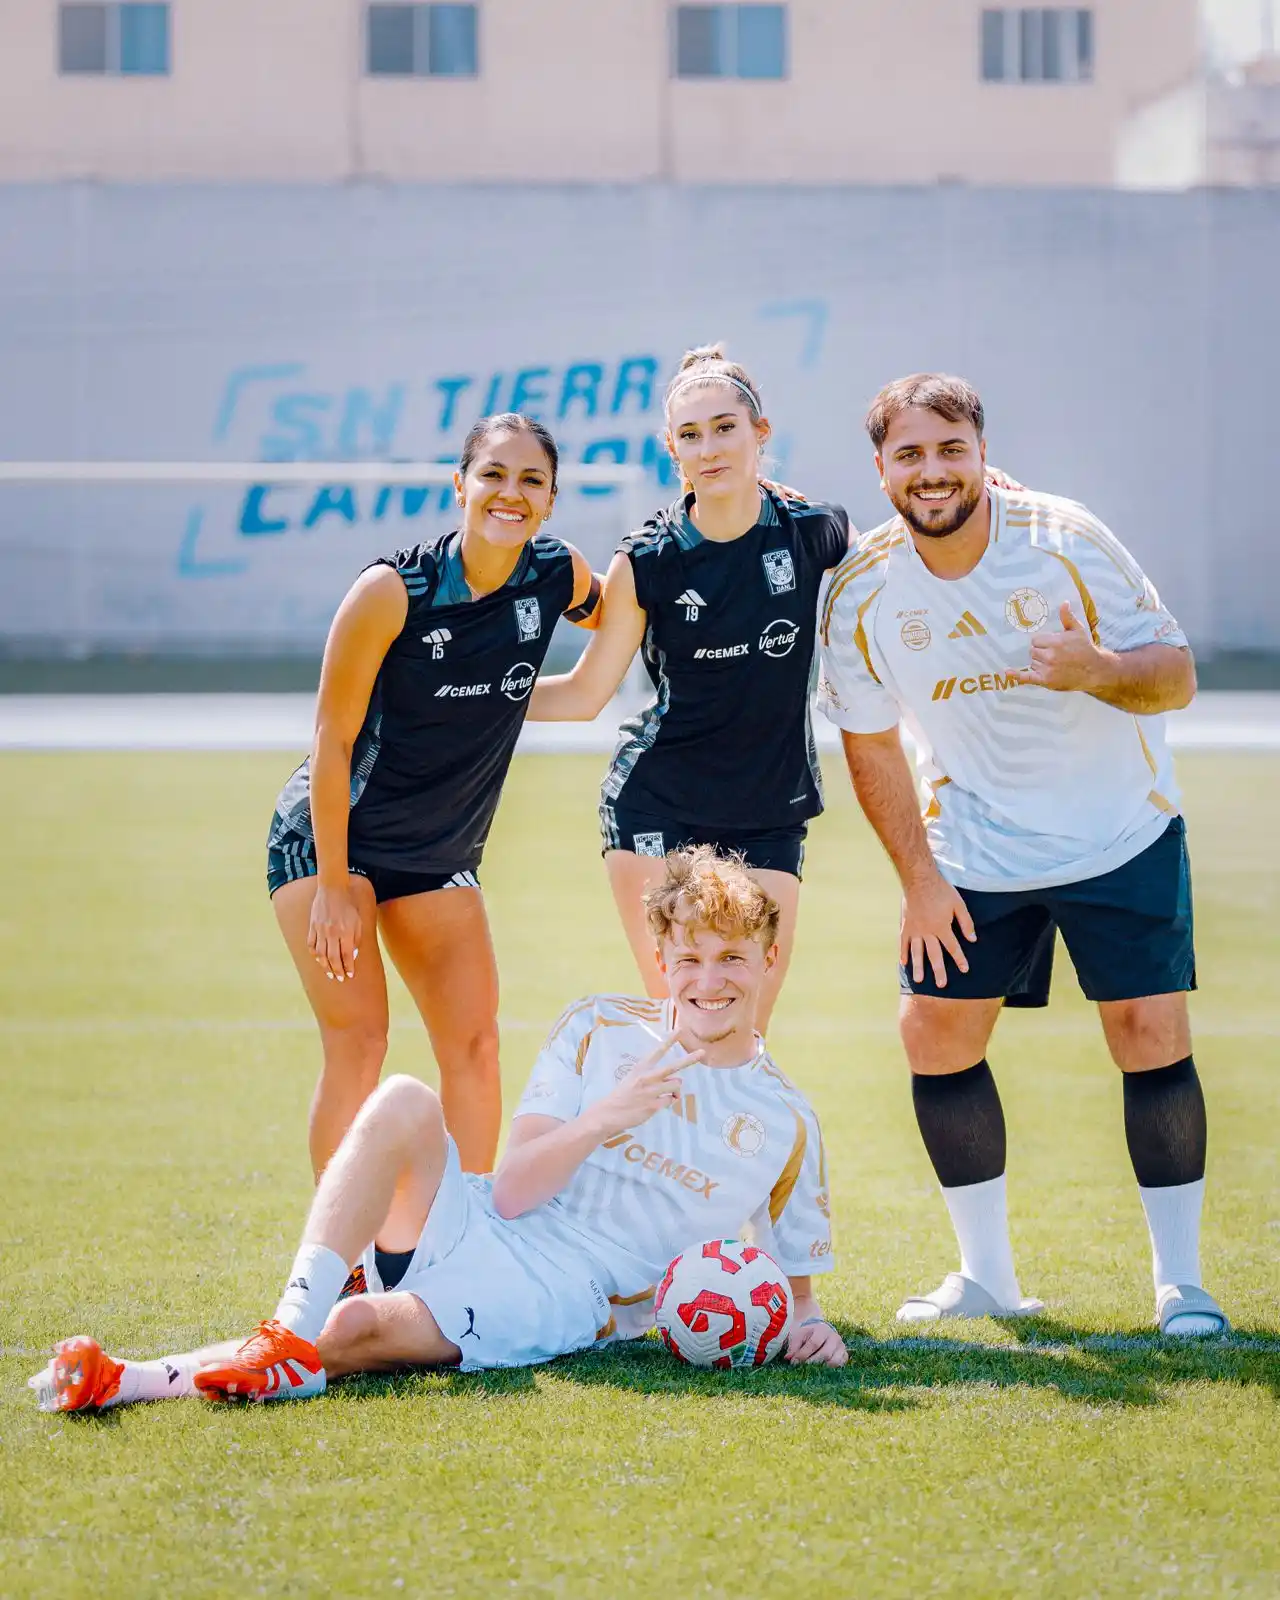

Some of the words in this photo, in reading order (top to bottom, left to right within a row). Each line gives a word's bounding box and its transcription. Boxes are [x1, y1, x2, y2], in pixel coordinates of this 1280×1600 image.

[436, 356, 660, 431] TIERR
[684, 605, 699, 622] 19
[431, 643, 444, 660] 15
[706, 643, 750, 660] CEMEX
[758, 630, 796, 652] Vertua
[450, 683, 492, 698] CEMEX
[500, 672, 534, 693] Vertua
[959, 667, 1029, 695] CEM
[623, 1143, 720, 1201] CEMEX
